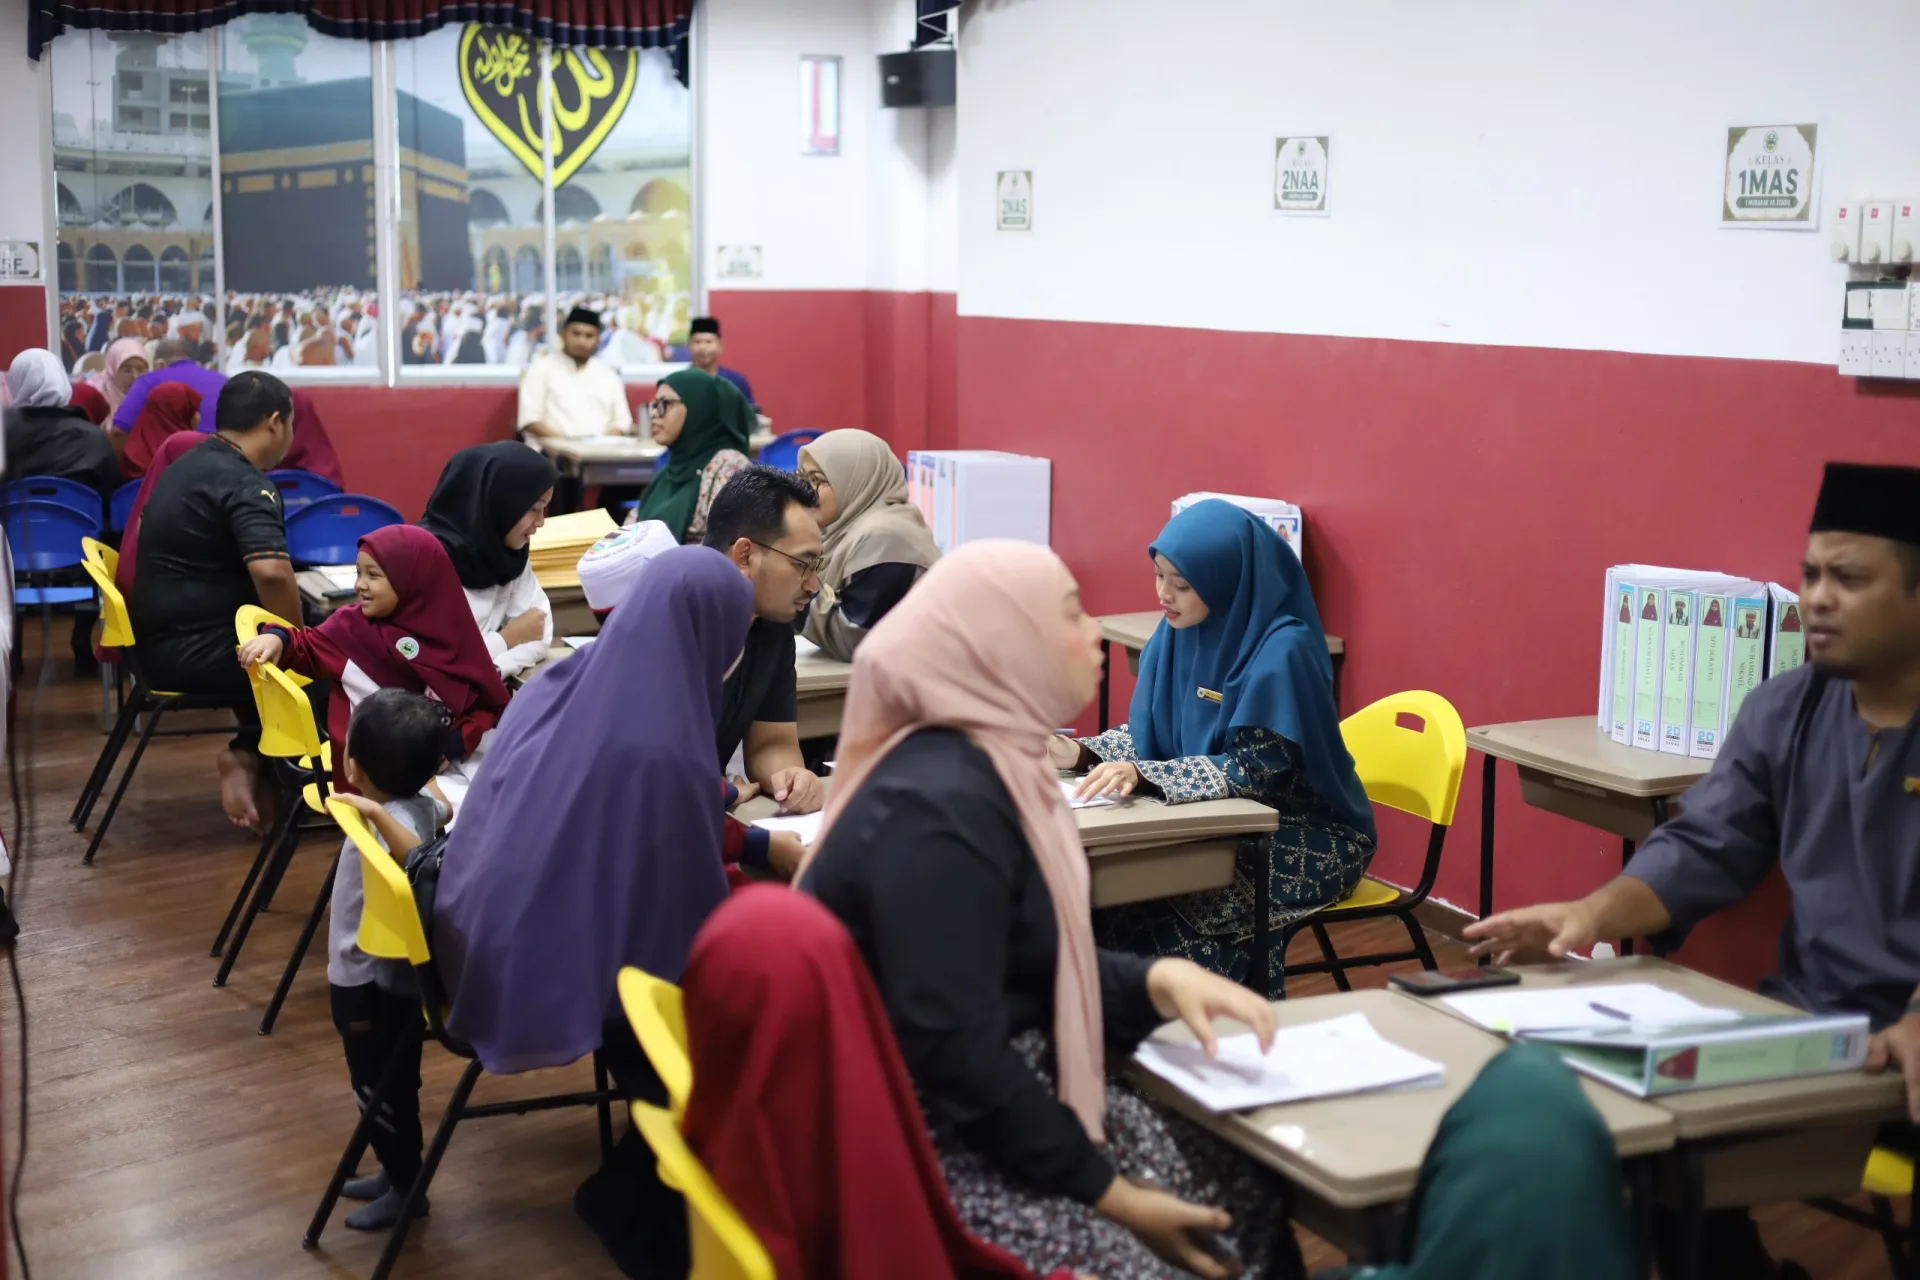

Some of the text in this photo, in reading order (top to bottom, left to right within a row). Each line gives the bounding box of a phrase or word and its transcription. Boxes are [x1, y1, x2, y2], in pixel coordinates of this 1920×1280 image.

[1755, 154, 1784, 165] KELAS
[1282, 170, 1319, 190] 2NAA
[1738, 168, 1798, 195] 1MAS
[1747, 644, 1757, 686] MUHAMMAD
[1738, 661, 1746, 688] MIKAEL
[1638, 721, 1651, 732] 2D
[1666, 725, 1681, 736] 2D
[1698, 731, 1715, 742] 2D
